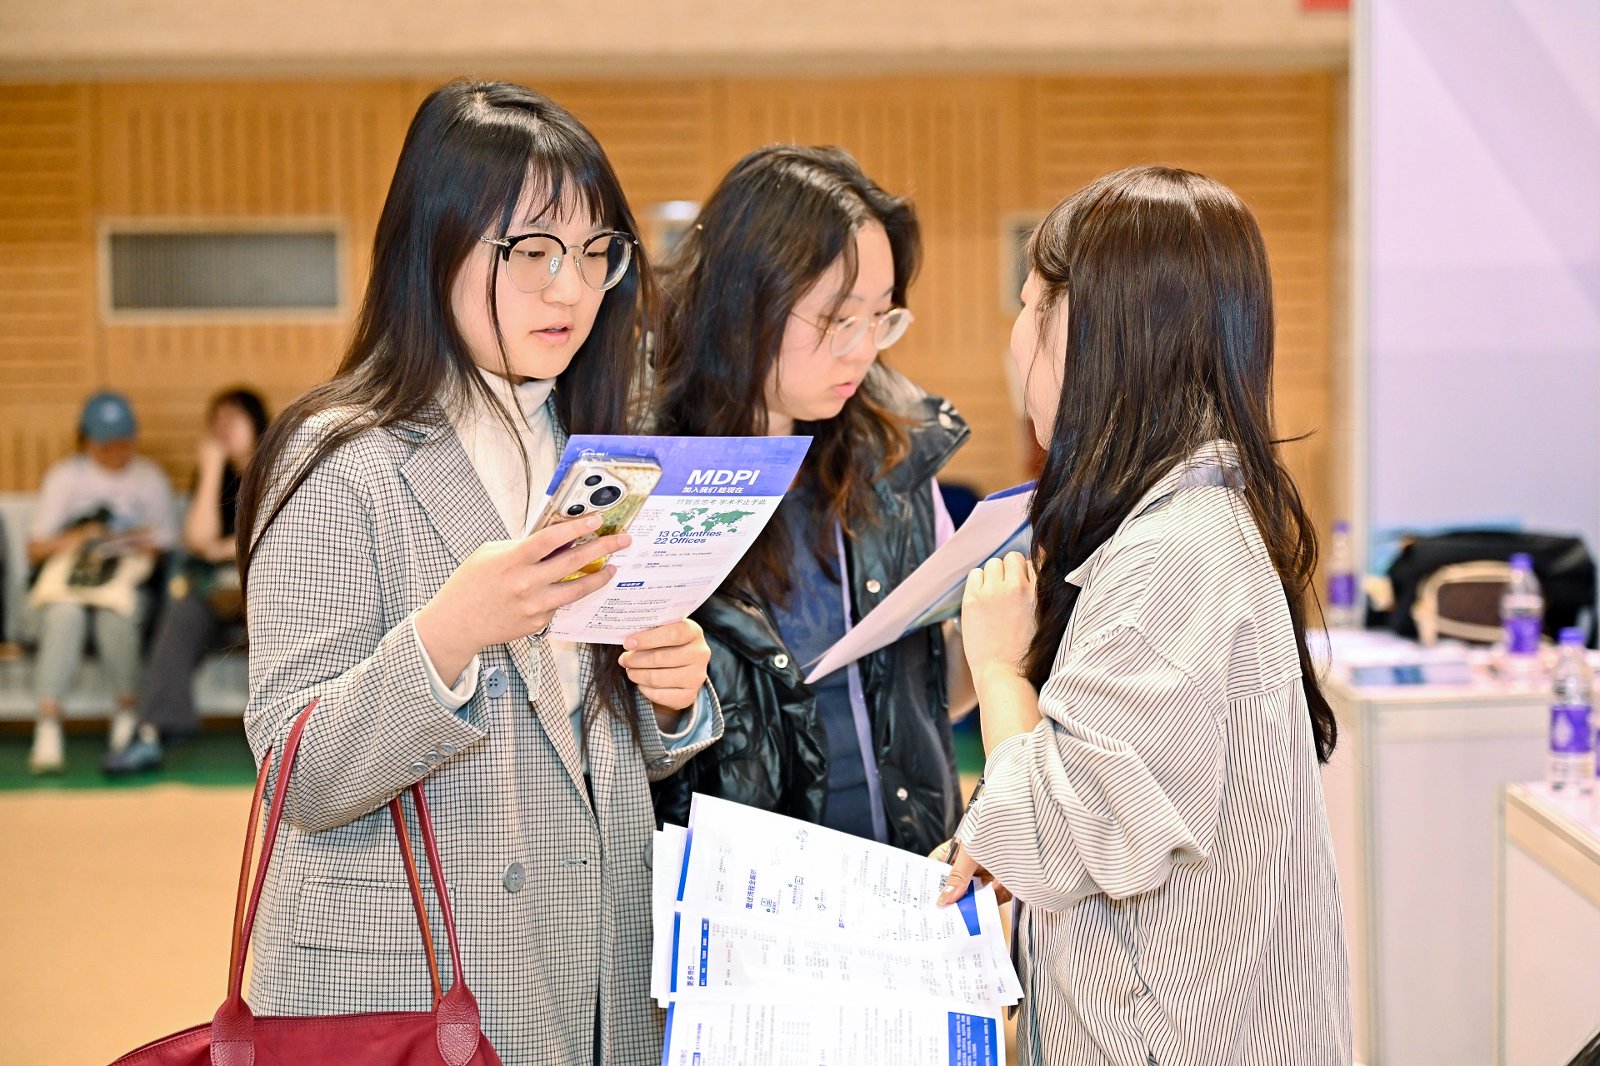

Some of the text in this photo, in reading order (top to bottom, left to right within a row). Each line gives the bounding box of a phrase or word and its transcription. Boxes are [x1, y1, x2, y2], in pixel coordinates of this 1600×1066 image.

[687, 469, 760, 486] MDPI
[658, 530, 722, 538] 13 Countries
[653, 537, 707, 545] 22 Offices
